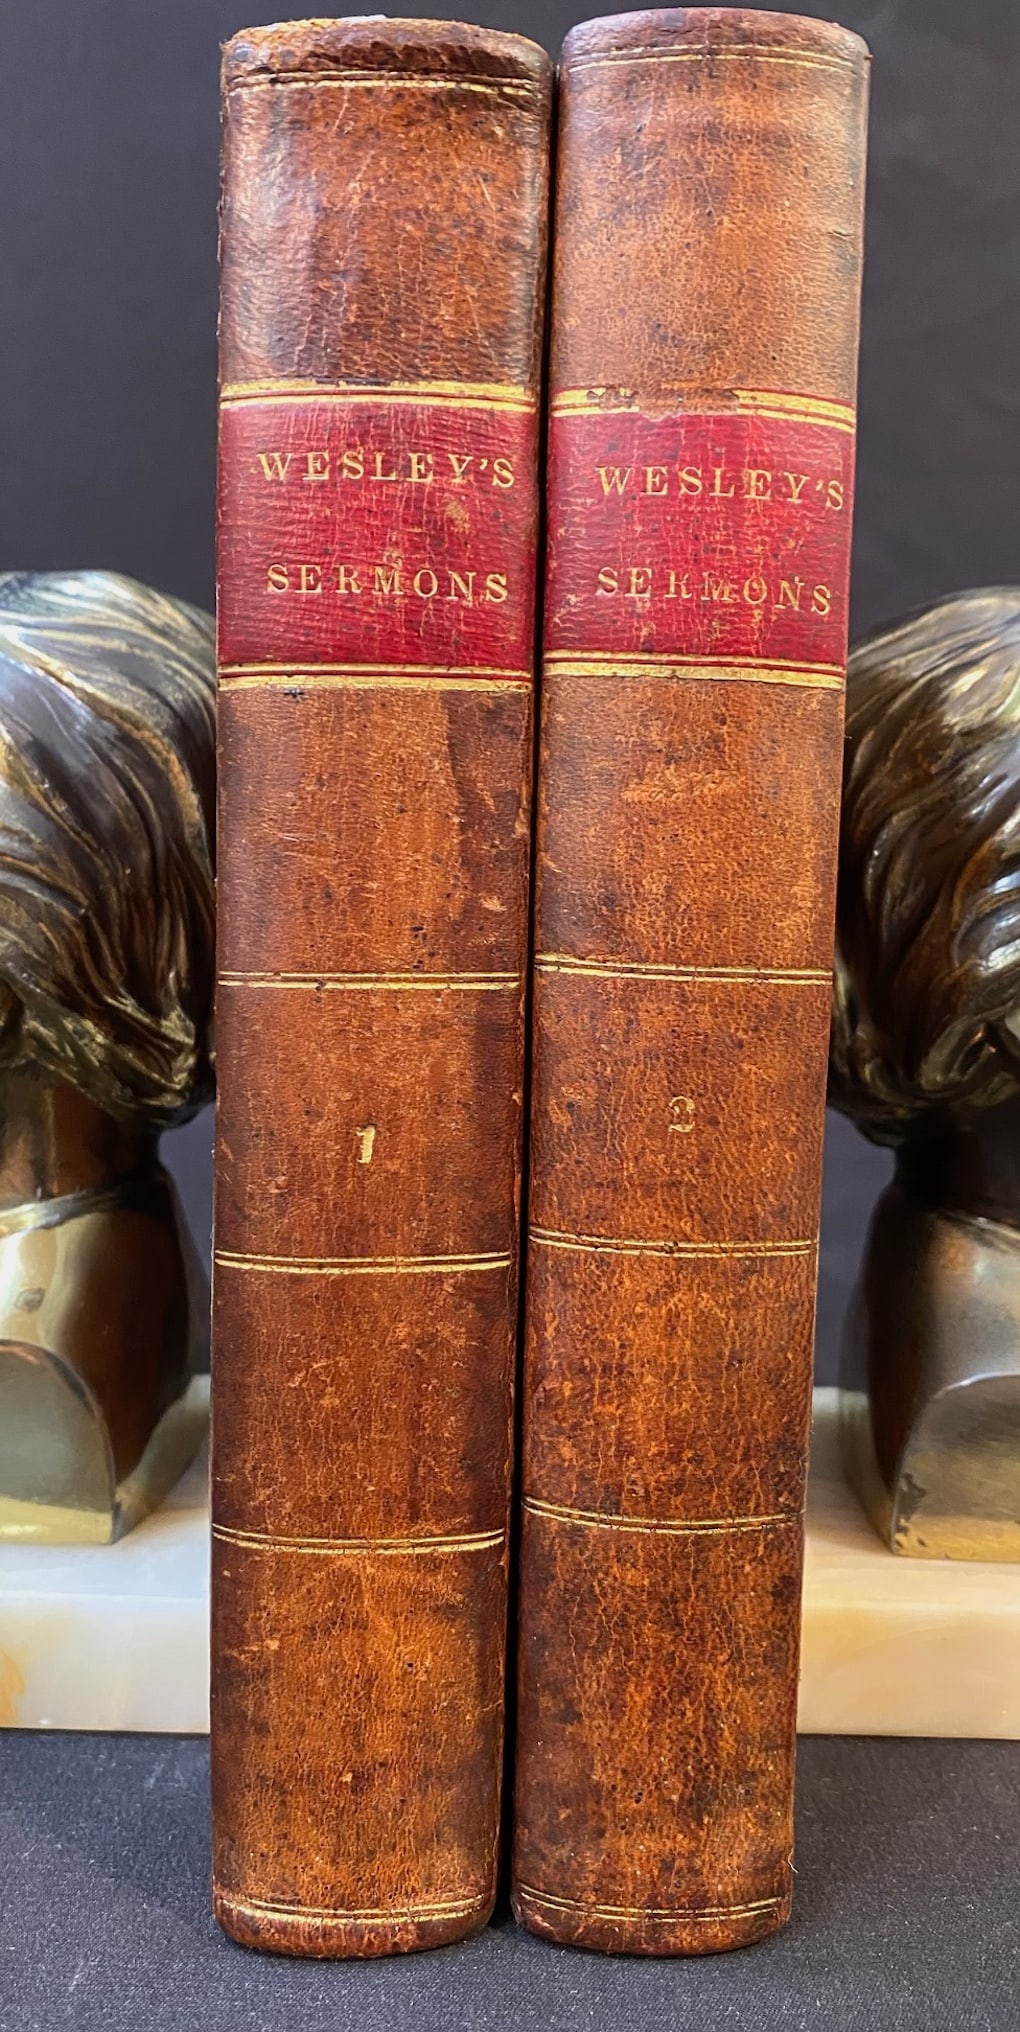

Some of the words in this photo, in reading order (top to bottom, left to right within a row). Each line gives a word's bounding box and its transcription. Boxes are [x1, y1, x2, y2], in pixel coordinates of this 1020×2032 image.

[257, 451, 516, 488] WESLEY'S
[596, 466, 844, 511] WESLEY'S
[266, 563, 508, 603] SERMONS
[597, 566, 832, 614] SERMONS
[355, 1126, 376, 1164] 1
